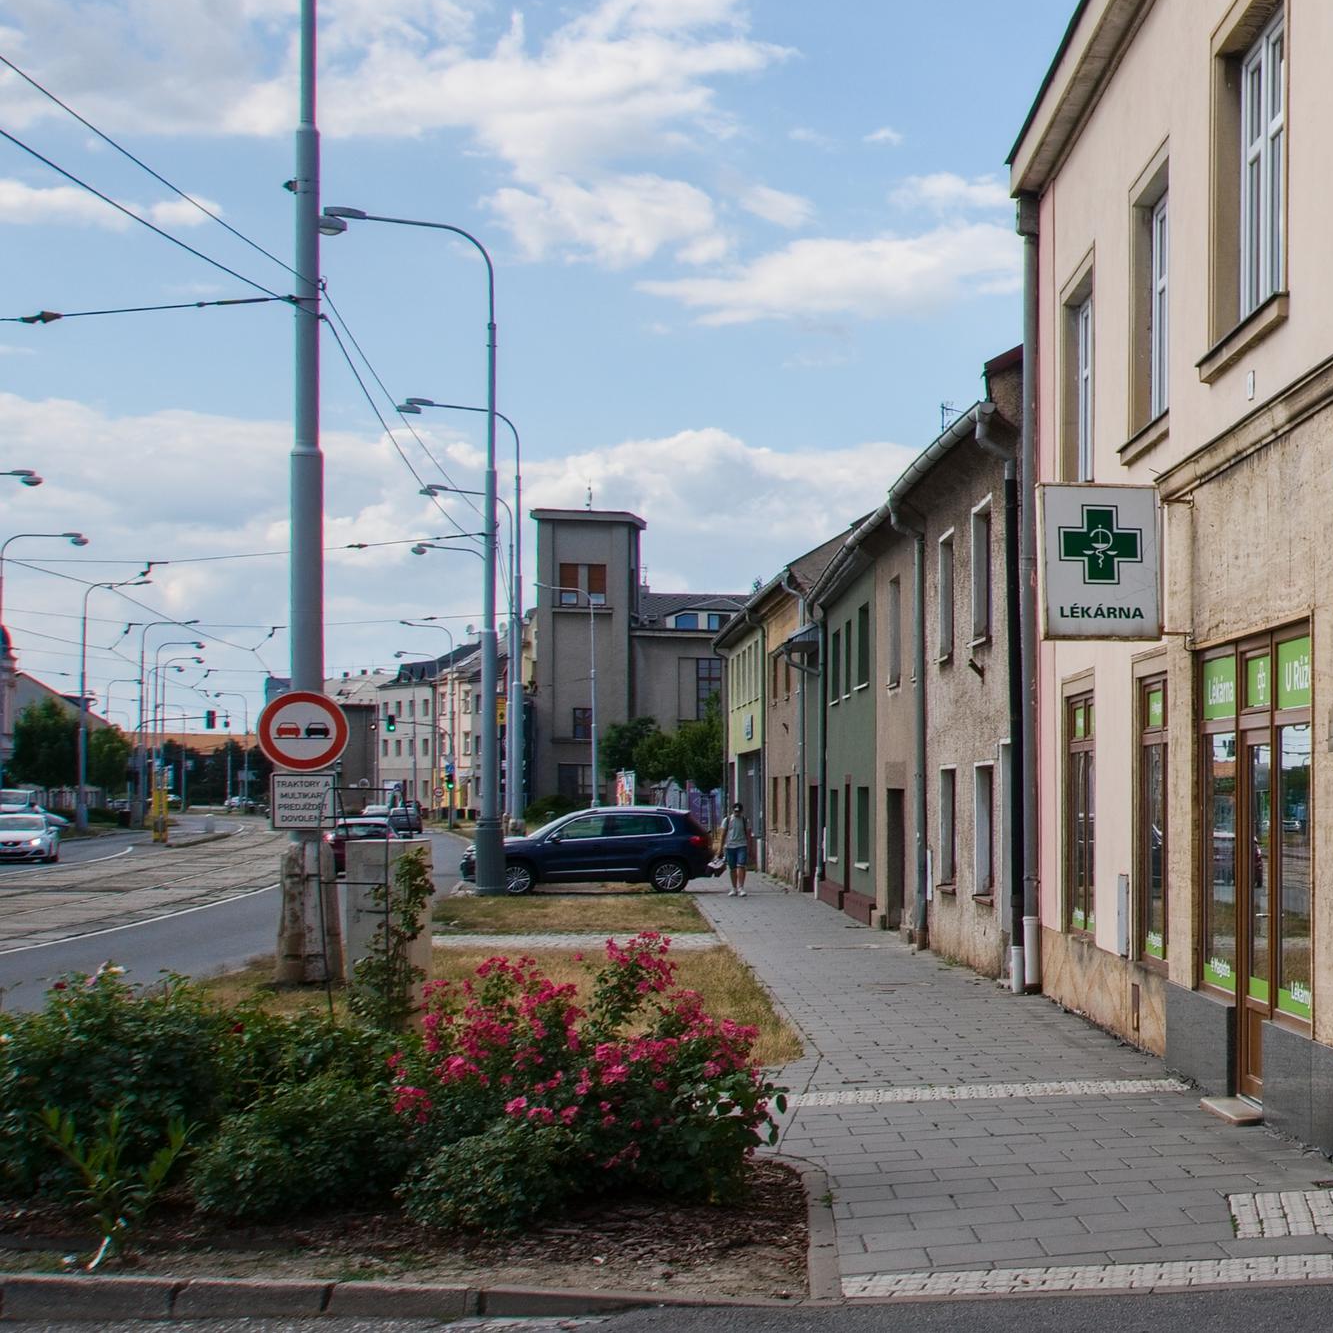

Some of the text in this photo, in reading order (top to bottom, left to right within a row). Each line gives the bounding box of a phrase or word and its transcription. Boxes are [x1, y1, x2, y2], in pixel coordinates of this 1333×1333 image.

[1060, 603, 1144, 619] LÉKÁRNA
[1208, 675, 1234, 705] Lékárna
[1285, 662, 1292, 692] U
[276, 780, 331, 788] TRAKTORY A
